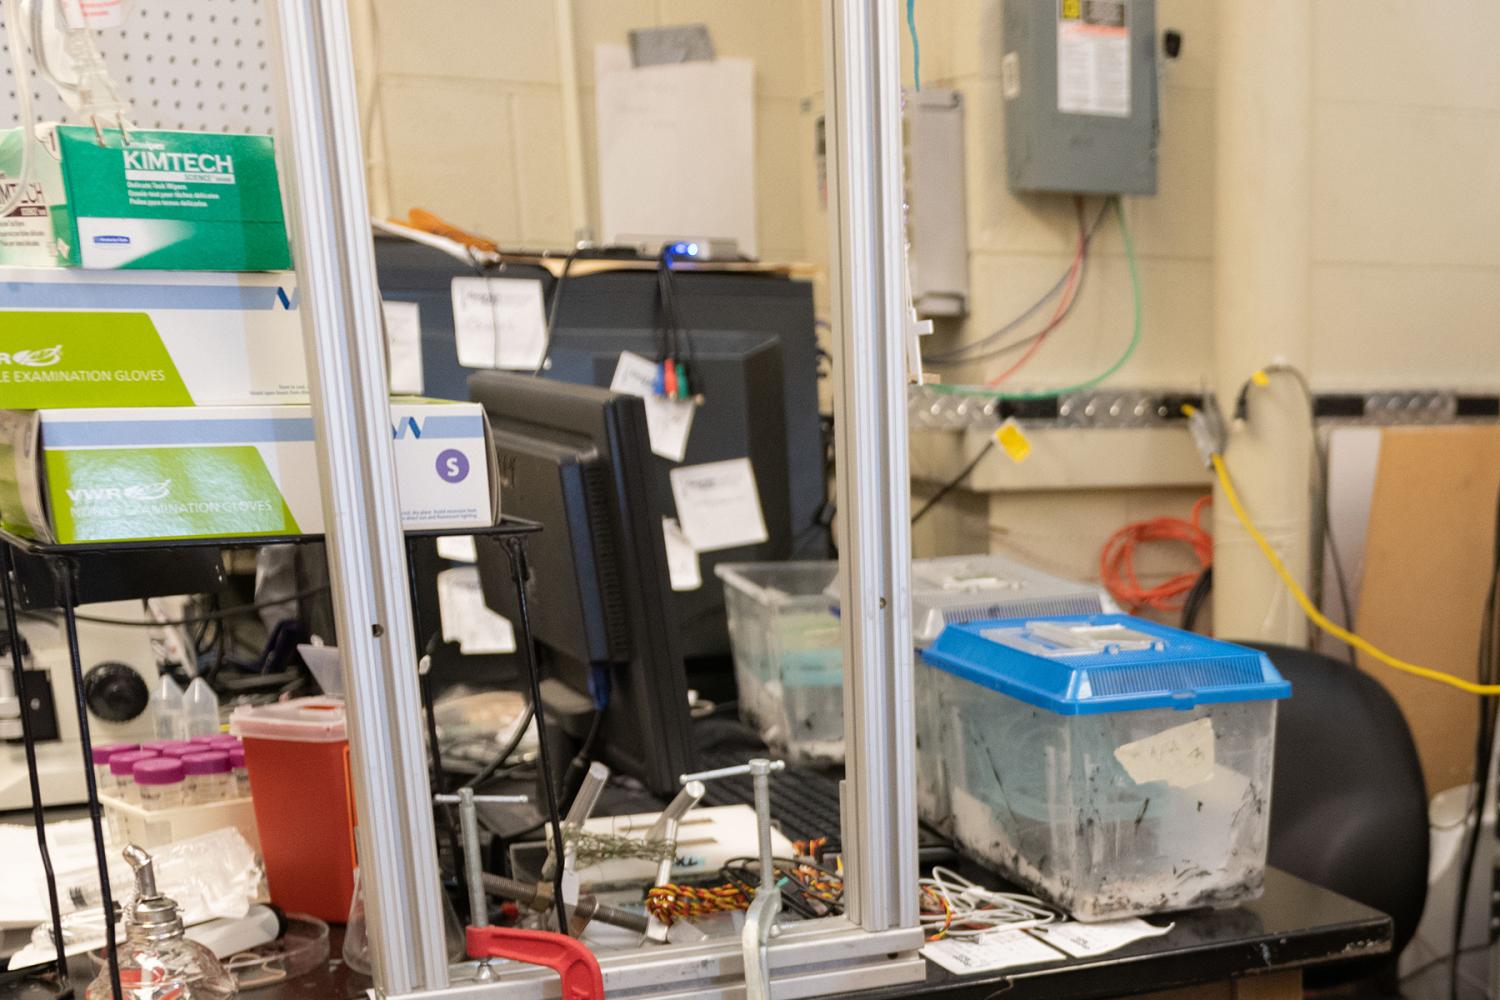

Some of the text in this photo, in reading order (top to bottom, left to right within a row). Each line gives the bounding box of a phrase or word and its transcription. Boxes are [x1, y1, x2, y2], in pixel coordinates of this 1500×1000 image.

[123, 151, 234, 173] KIMTECH
[13, 369, 112, 383] EXAMINATION
[115, 369, 166, 382] GLOVES
[446, 457, 460, 477] S
[66, 487, 122, 501] VWR
